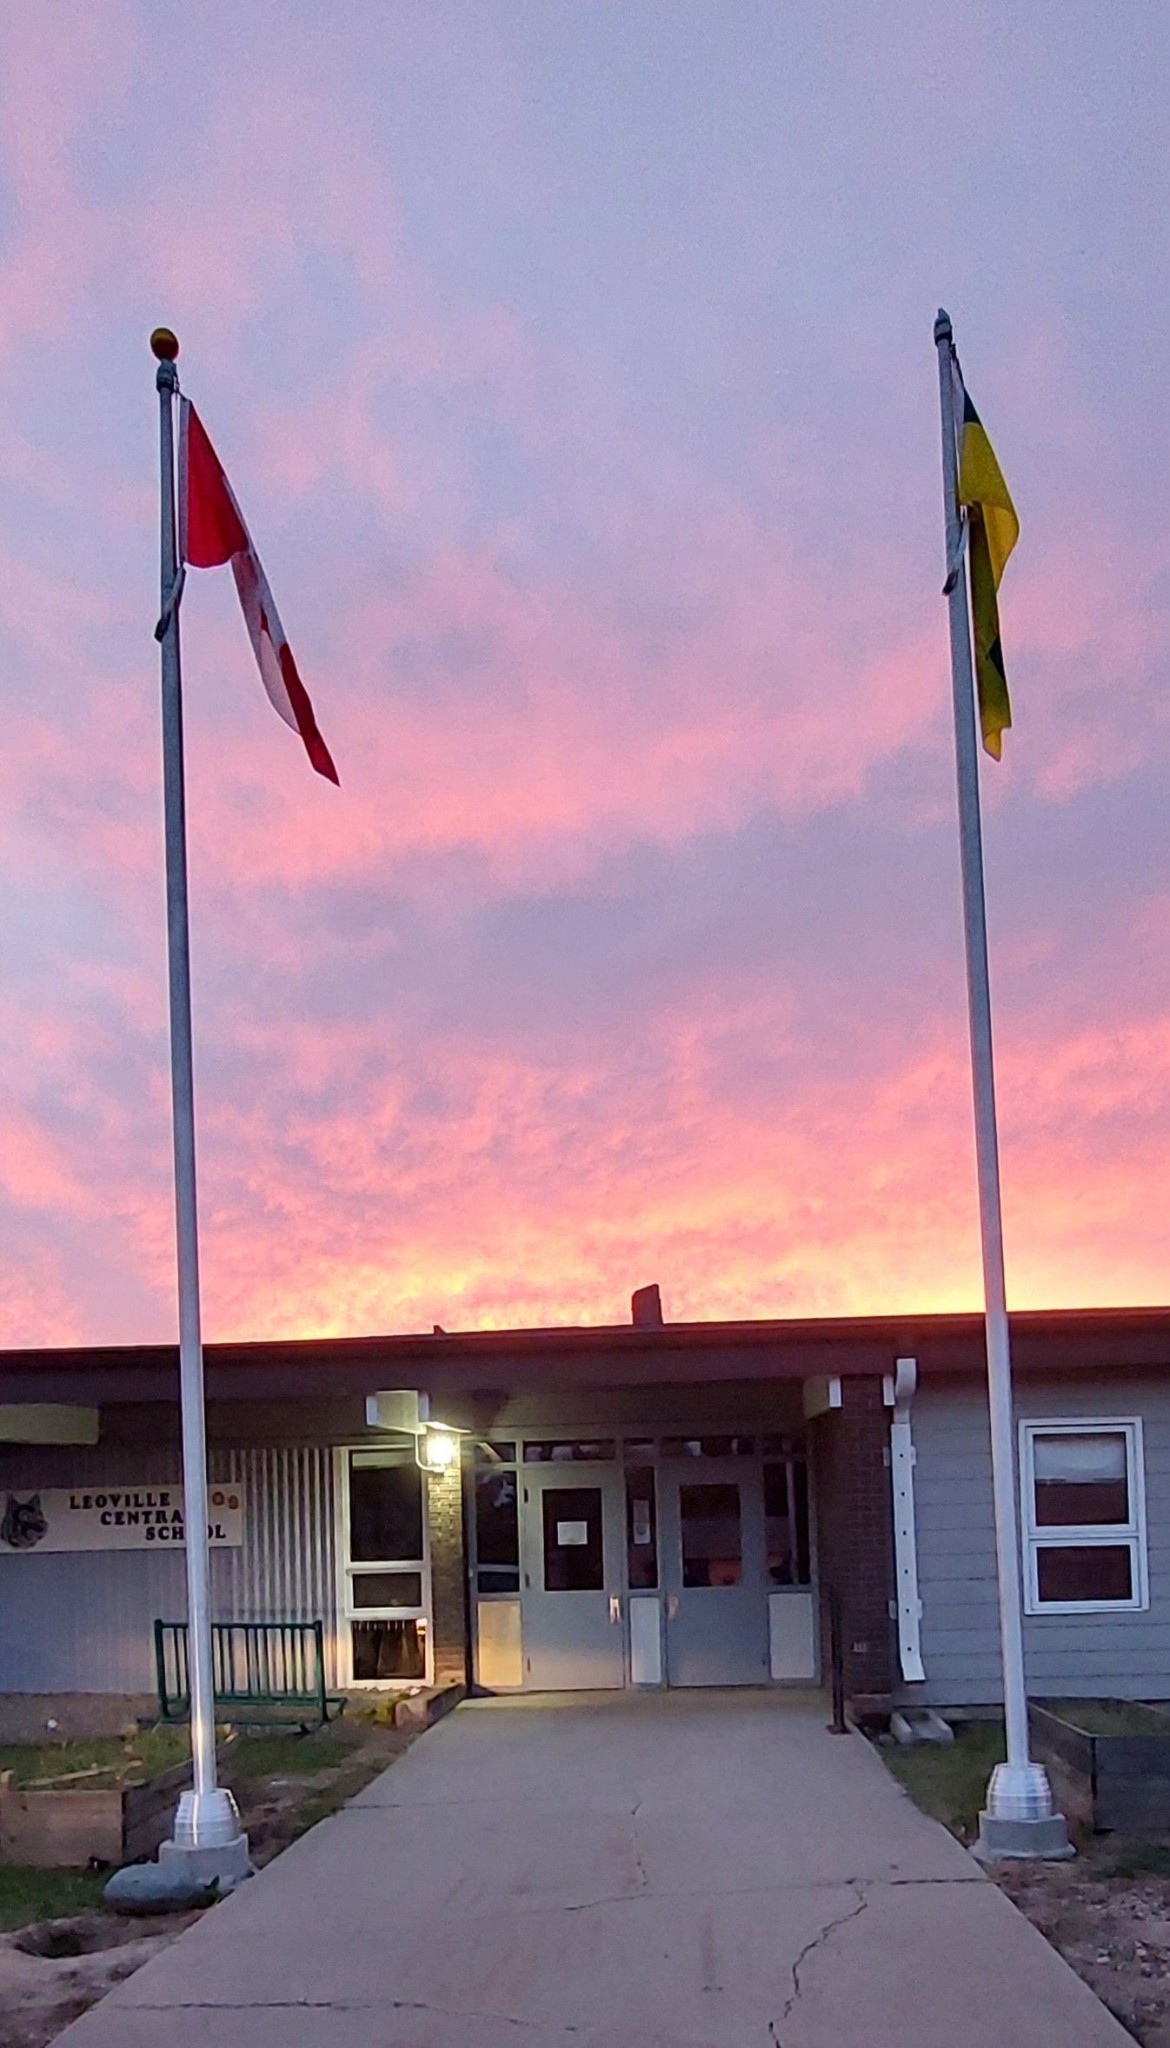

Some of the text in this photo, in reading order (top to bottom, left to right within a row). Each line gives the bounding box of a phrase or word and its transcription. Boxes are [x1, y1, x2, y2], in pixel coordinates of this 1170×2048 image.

[69, 1492, 170, 1510] LEOVILLE
[100, 1509, 184, 1526] CENTRA
[145, 1524, 226, 1541] SCHL
